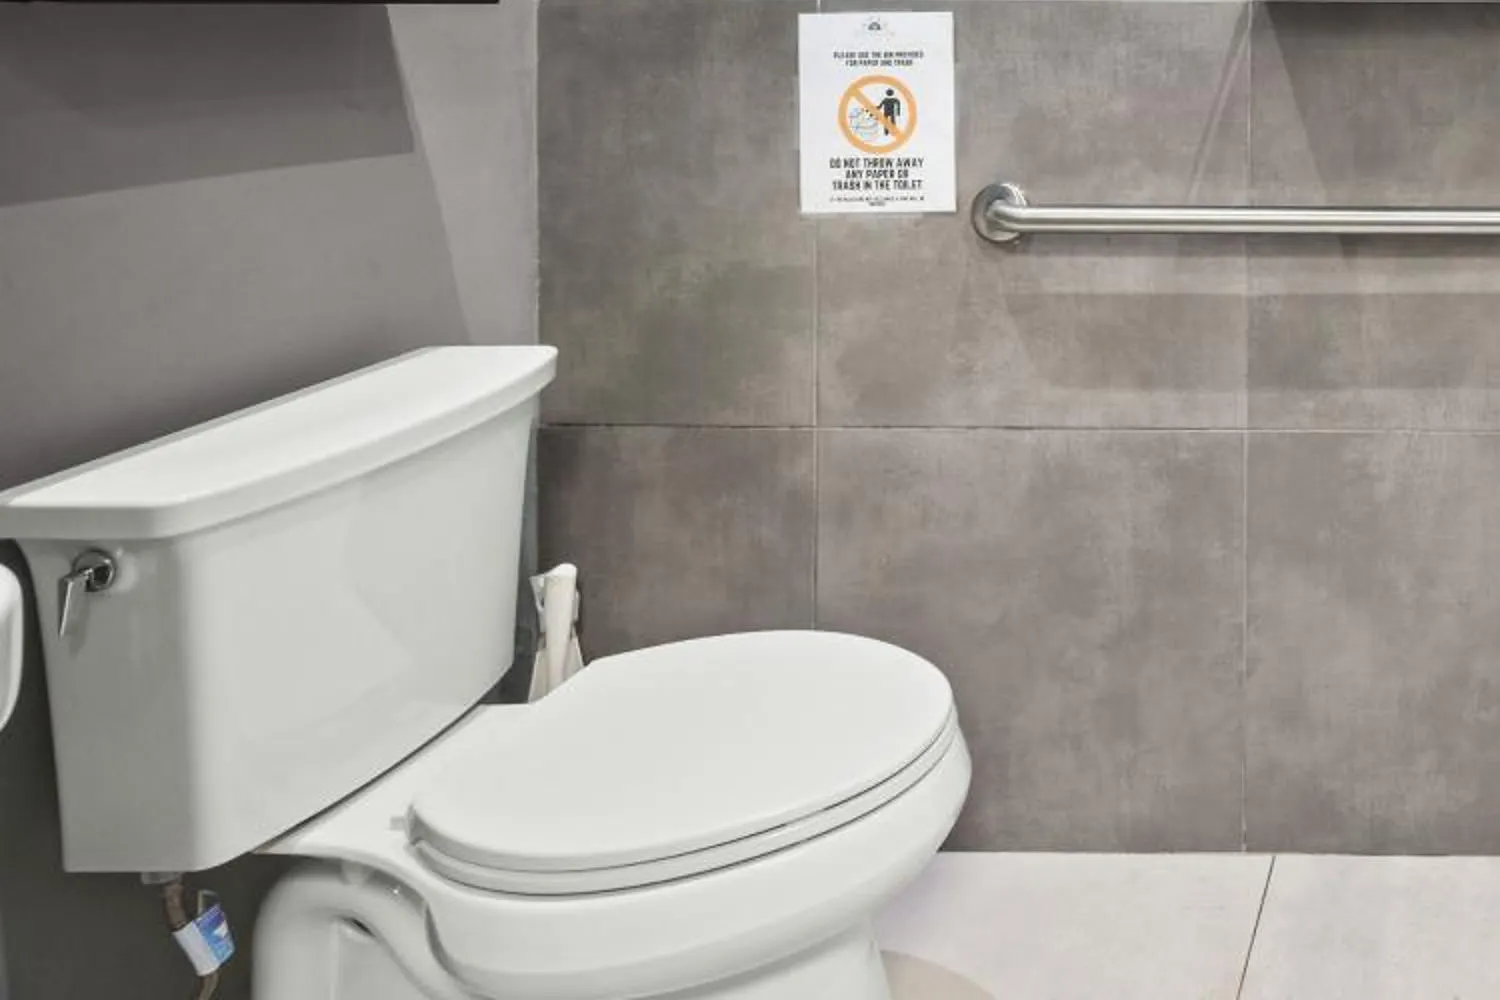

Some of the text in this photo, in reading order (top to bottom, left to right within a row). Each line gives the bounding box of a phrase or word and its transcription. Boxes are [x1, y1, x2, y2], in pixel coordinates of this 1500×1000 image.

[829, 158, 841, 168] DO
[843, 158, 860, 168] NOT
[896, 158, 924, 168] AWAY
[845, 169, 909, 178] ANY PAPER OR
[832, 179, 922, 190] TRASH IN THE TOILET
